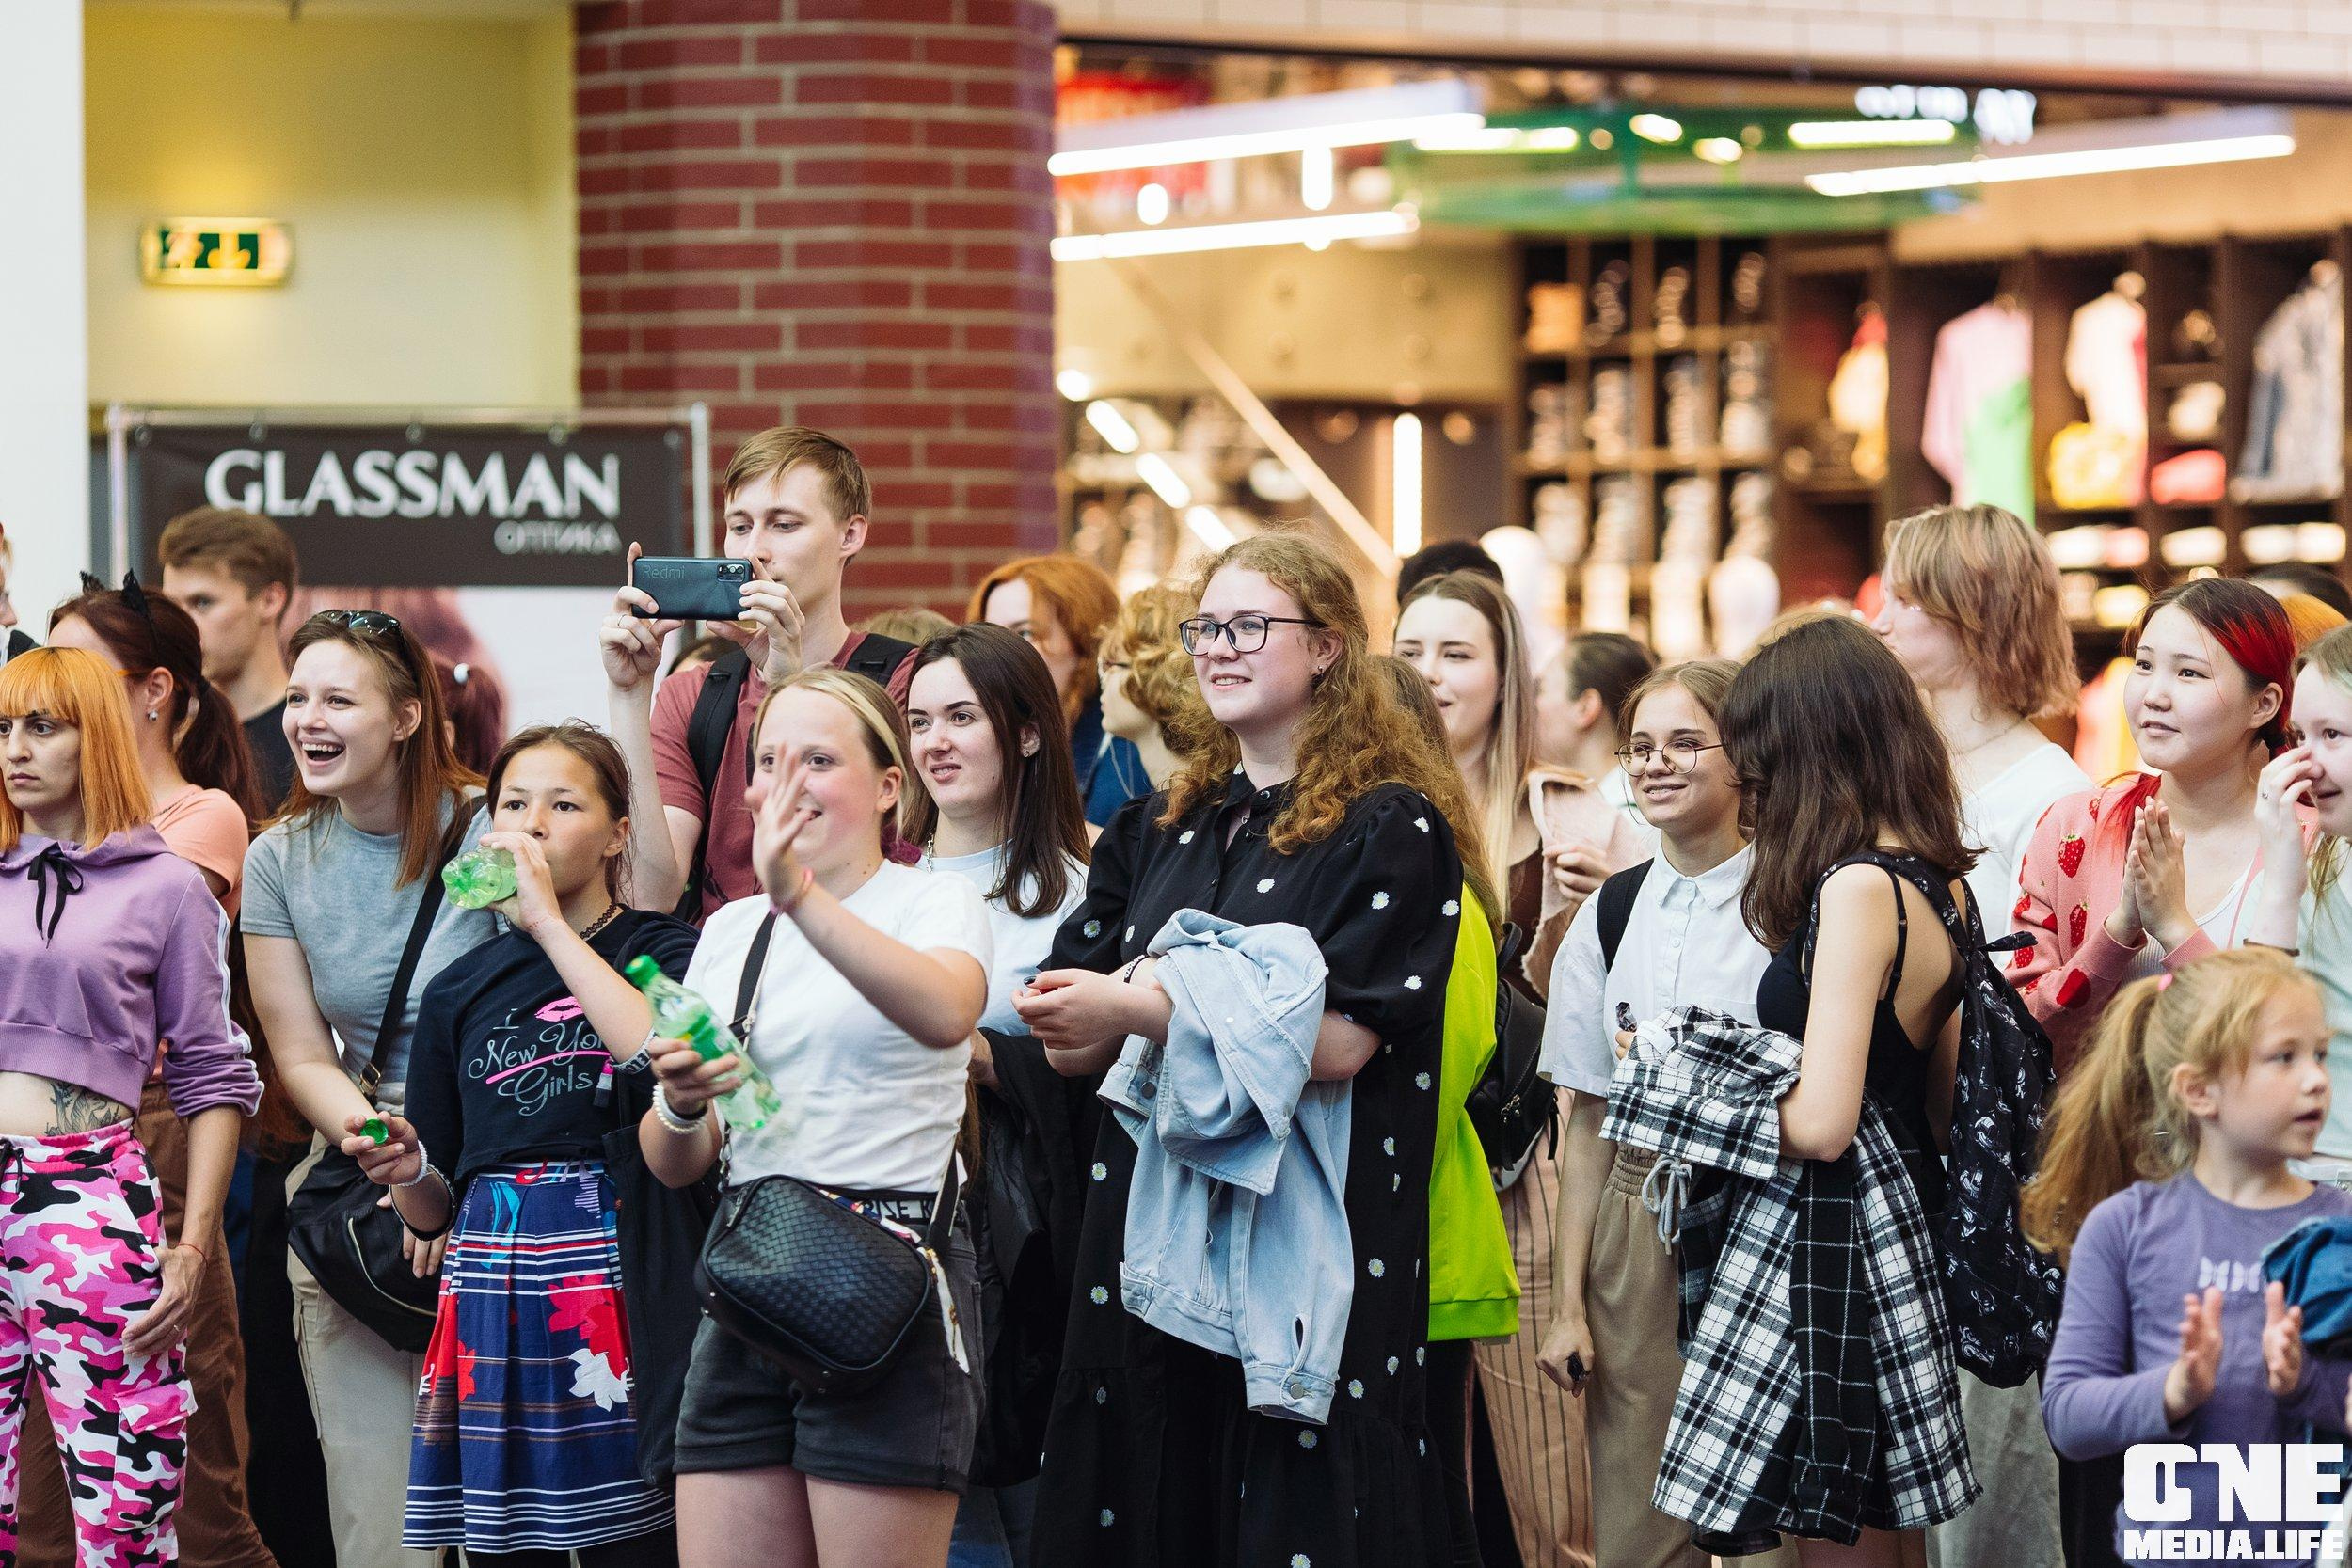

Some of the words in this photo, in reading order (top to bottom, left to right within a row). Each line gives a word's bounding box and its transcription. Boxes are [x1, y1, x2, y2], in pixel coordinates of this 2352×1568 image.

[205, 448, 620, 519] GLASSMAN
[642, 565, 685, 579] Redmi
[468, 1036, 537, 1079] New
[497, 1064, 593, 1117] Girls
